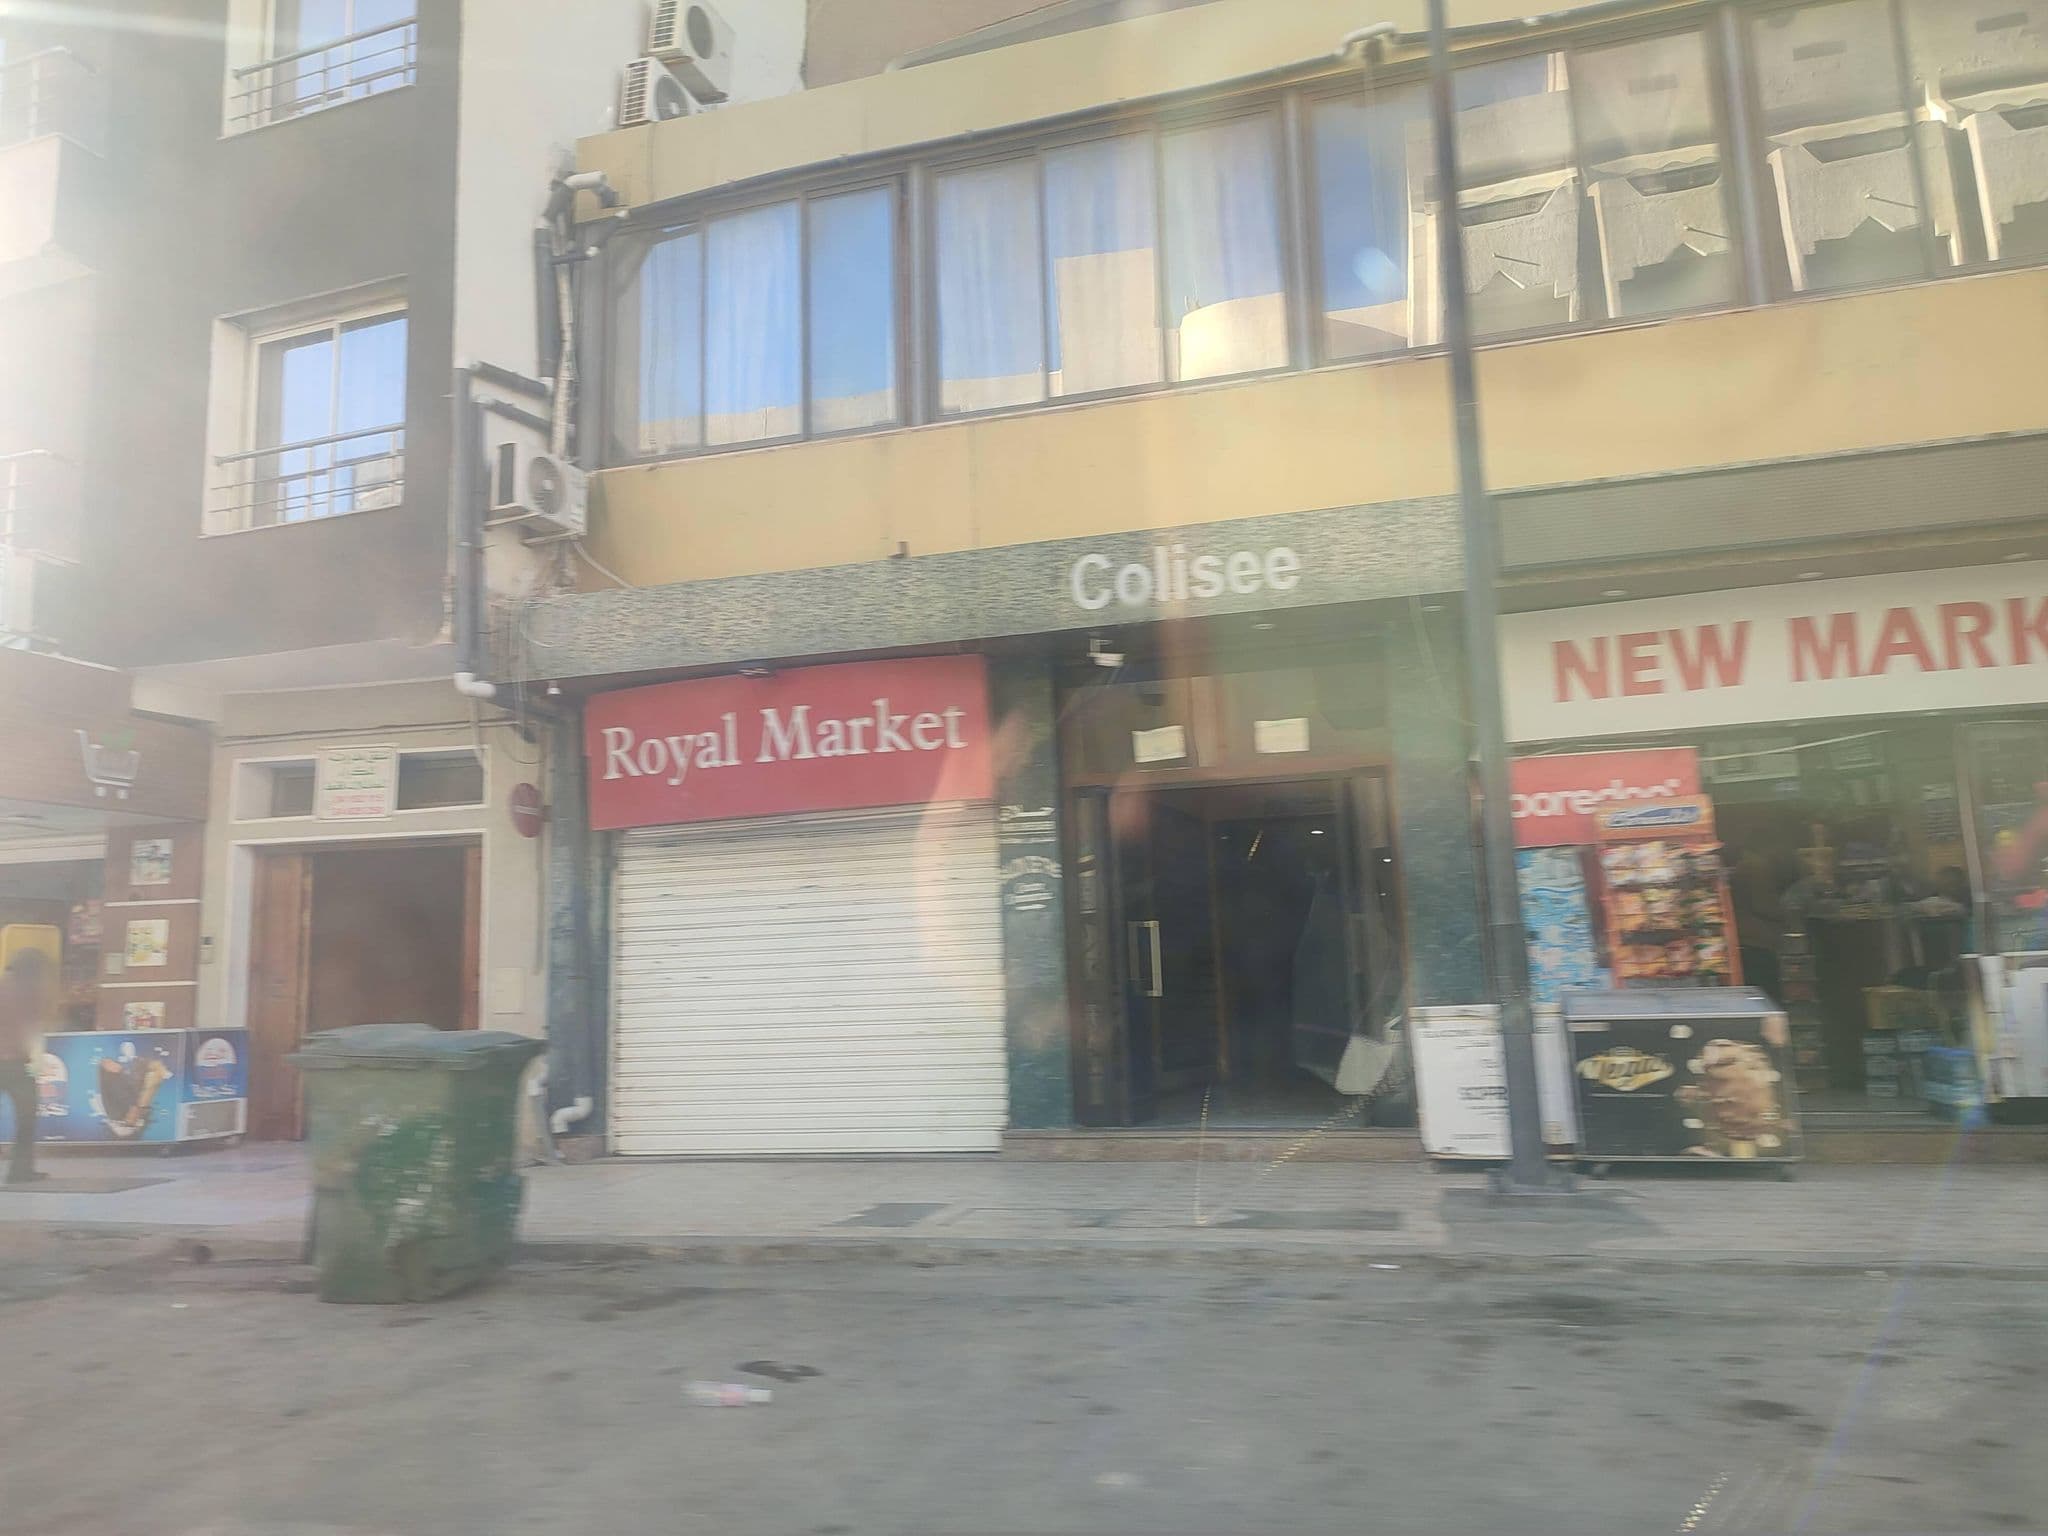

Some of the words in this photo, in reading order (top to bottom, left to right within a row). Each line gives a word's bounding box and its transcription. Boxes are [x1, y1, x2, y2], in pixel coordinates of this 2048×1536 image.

[1071, 544, 1300, 610] Colisee
[1551, 620, 1752, 703] NEW
[600, 711, 742, 786] Royal
[755, 697, 969, 764] Market
